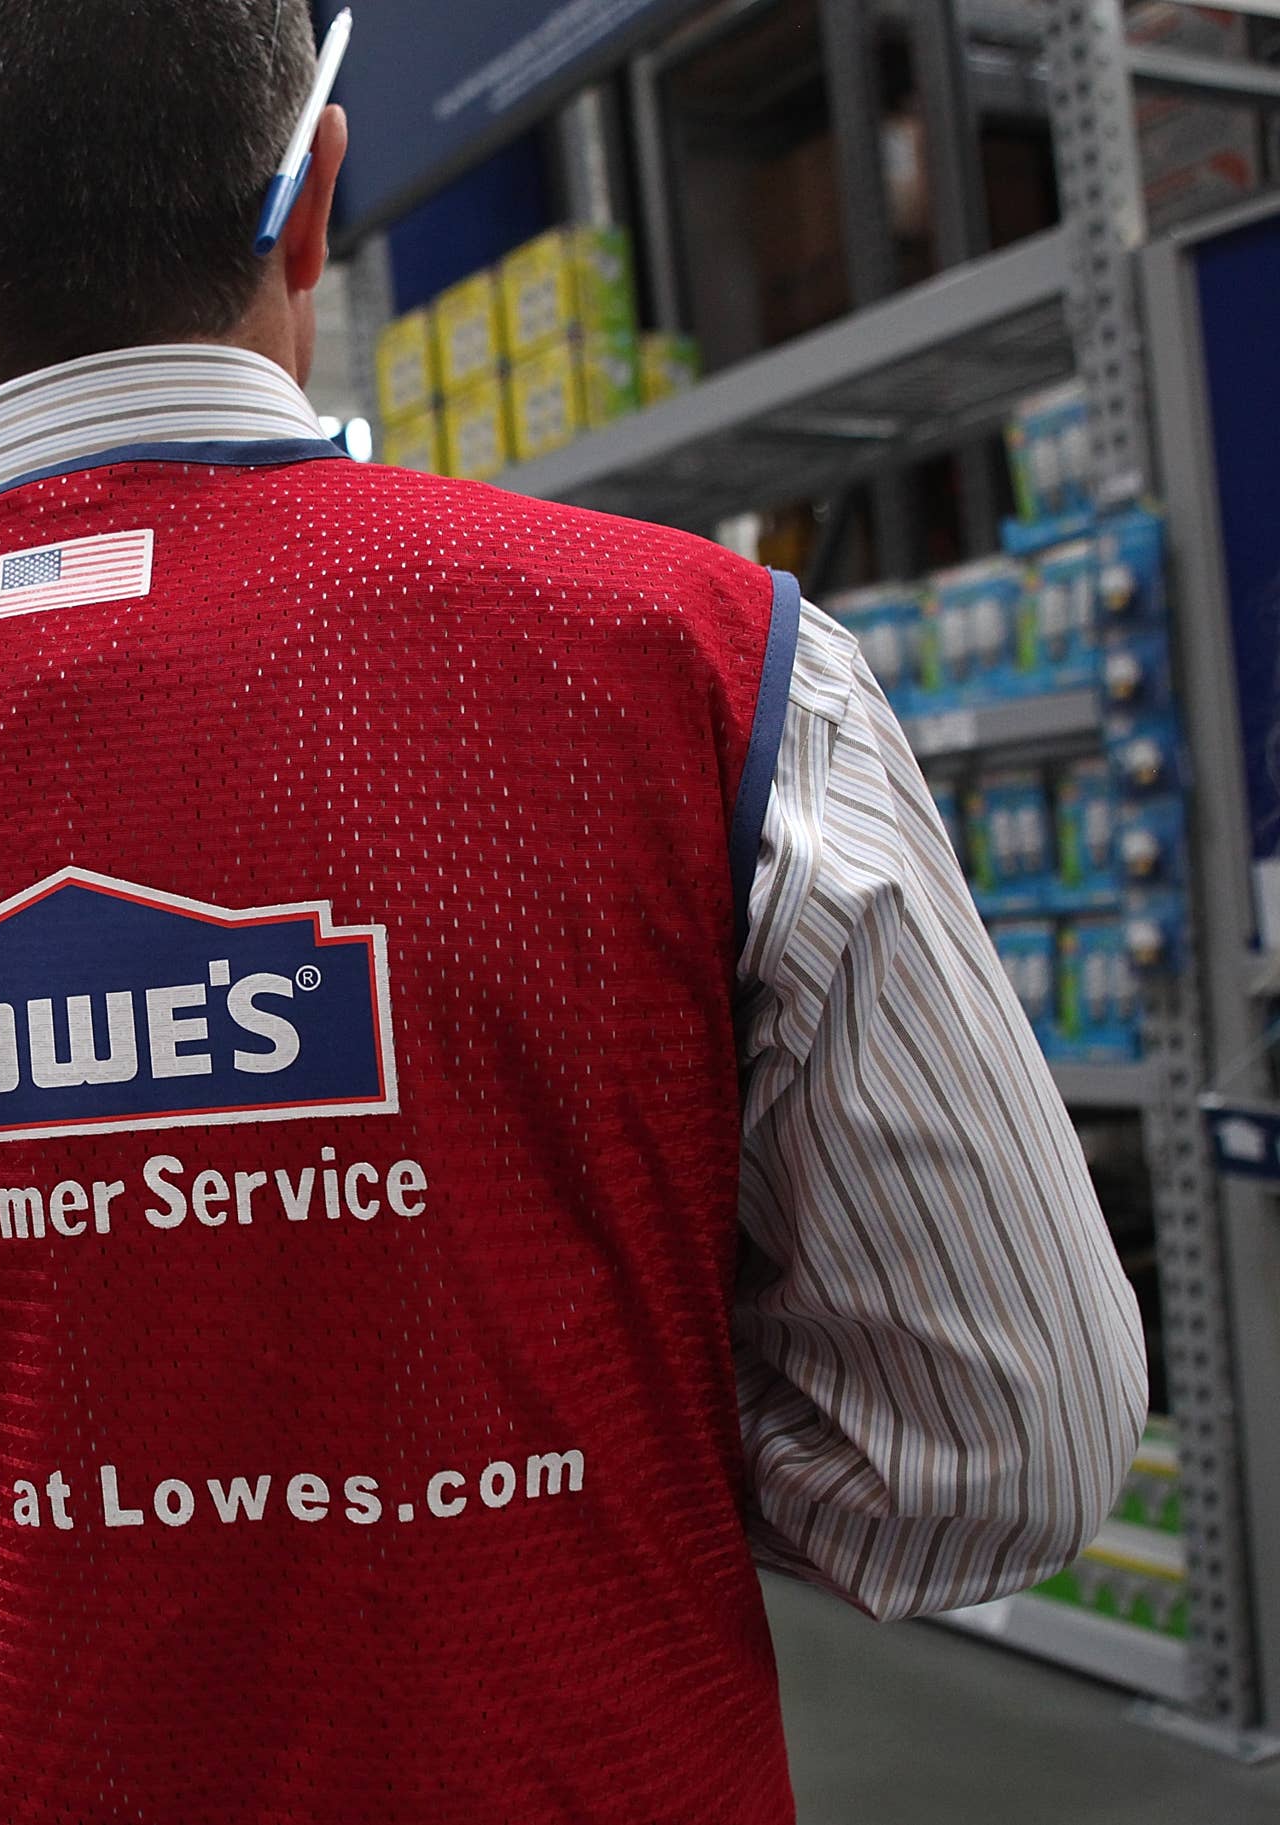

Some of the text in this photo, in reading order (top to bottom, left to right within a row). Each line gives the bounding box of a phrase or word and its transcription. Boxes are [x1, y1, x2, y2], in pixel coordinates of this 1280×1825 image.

[142, 1146, 428, 1230] Service
[13, 1470, 74, 1530] at
[100, 1449, 585, 1527] Lowes.com
